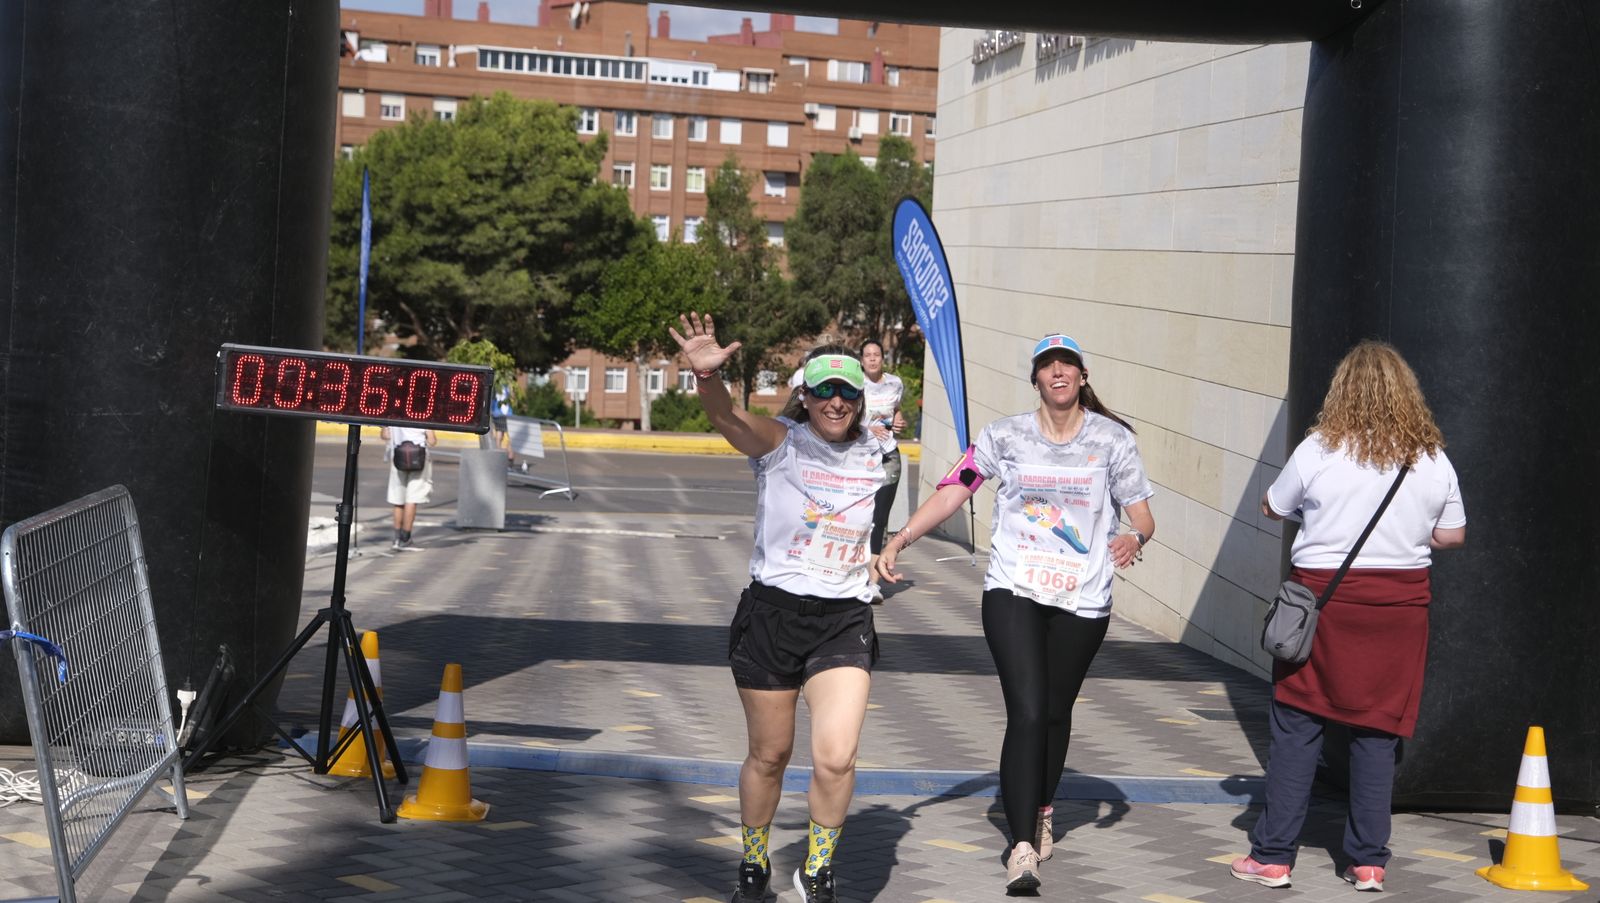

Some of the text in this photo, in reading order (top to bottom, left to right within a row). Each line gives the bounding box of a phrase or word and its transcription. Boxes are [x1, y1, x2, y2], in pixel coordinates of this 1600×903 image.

[232, 354, 479, 424] 00:36:09
[823, 541, 865, 563] 1128
[1025, 567, 1078, 592] 1068
